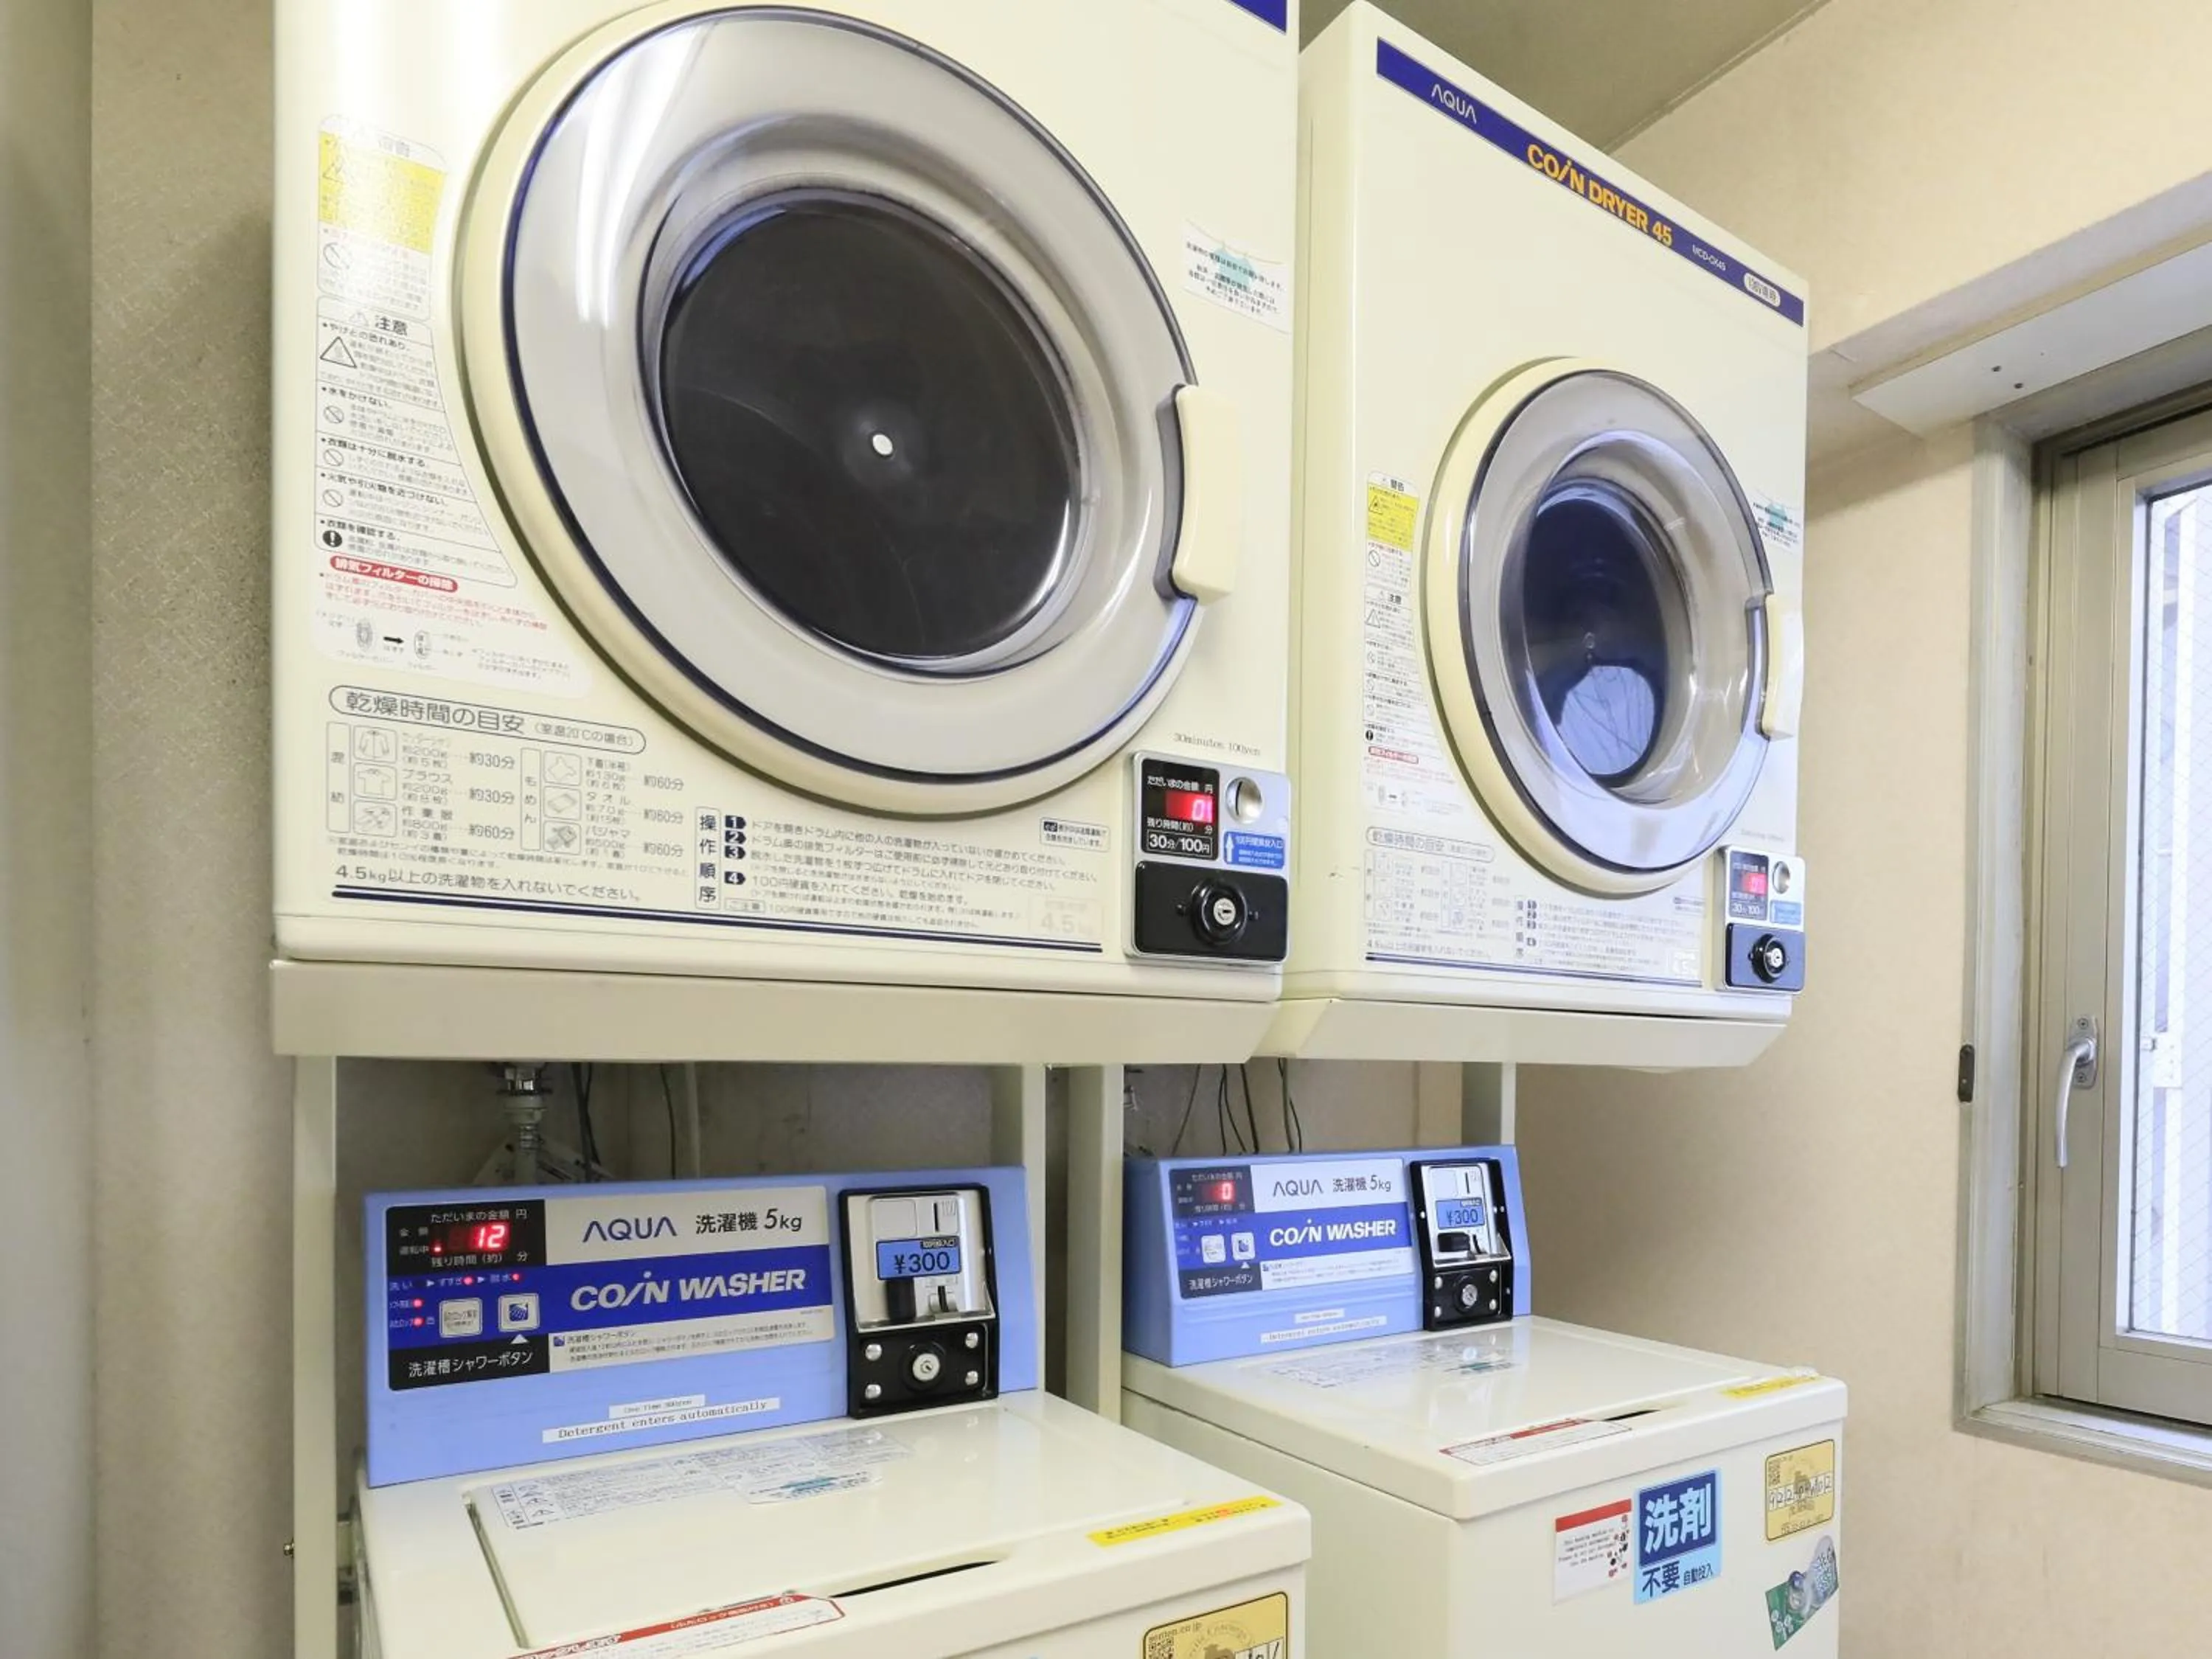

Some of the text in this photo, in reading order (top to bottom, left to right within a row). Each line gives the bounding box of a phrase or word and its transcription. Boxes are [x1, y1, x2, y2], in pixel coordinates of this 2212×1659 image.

[1430, 83, 1477, 124] AQUA
[1588, 179, 1649, 234] DRYER
[1652, 221, 1673, 247] 45
[375, 315, 408, 336] 注意
[346, 691, 525, 735] 乾燥時間の目安
[1221, 1182, 1231, 1200] 0
[1273, 1174, 1392, 1197] AQUA 洗濯機 5kg
[431, 1209, 526, 1224] ただいまの金額 円
[582, 1208, 802, 1243] AQUA 洗濯機 5kg
[1447, 1208, 1479, 1226] ¥300
[479, 1225, 506, 1248] 12
[1327, 1219, 1396, 1242] WASHER
[517, 1251, 528, 1262] 分
[894, 1251, 950, 1275] ¥300
[680, 1268, 807, 1301] WASHER
[409, 1351, 534, 1377] 洗濯槽シャワーボタン
[558, 1401, 768, 1439] Detergent enters automatically
[1645, 1483, 1711, 1554] 洗剤
[1642, 1560, 1714, 1598] 不要 自動投入
